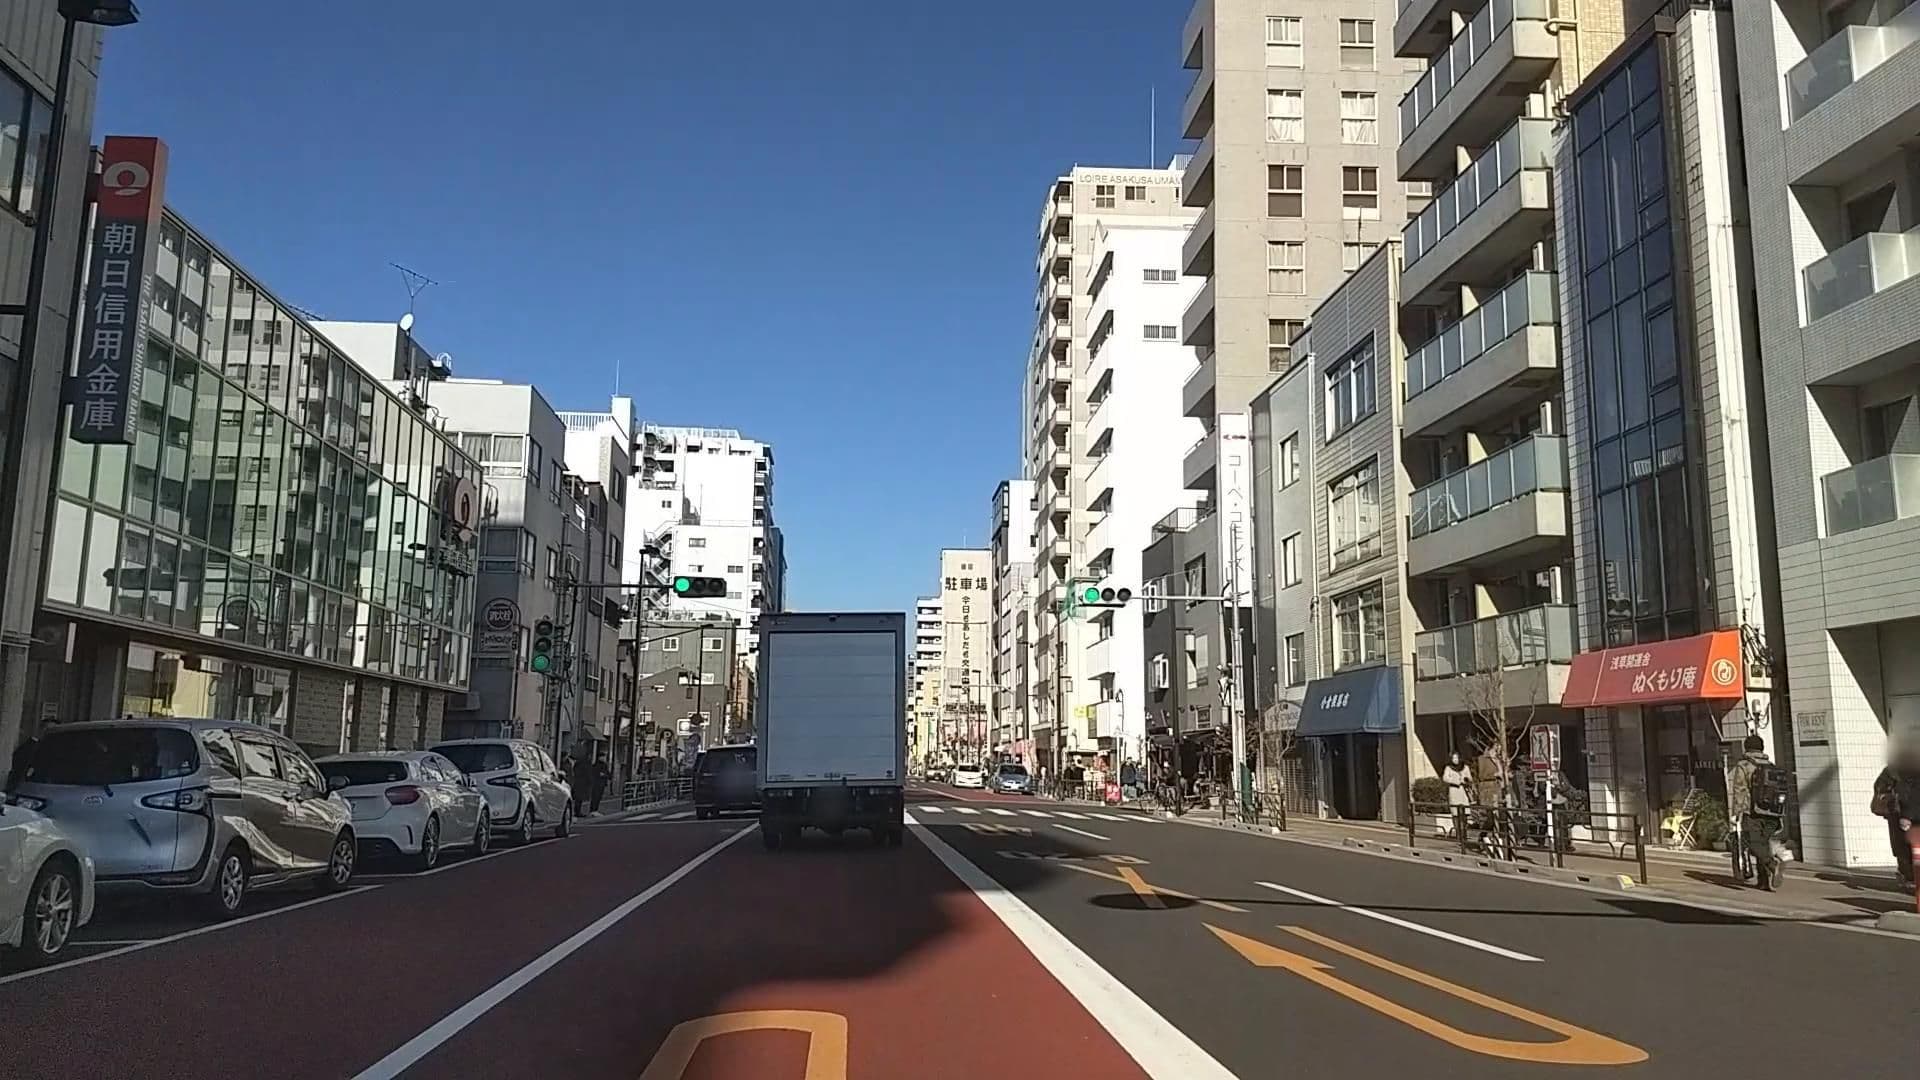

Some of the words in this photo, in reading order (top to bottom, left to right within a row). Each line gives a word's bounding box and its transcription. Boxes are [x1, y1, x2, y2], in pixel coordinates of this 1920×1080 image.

[1080, 174, 1107, 184] LOIRE
[1110, 175, 1153, 185] ASAKUSA
[80, 223, 137, 431] 朝日信用金庫
[945, 577, 989, 591] 駐車場
[1632, 665, 1697, 693] ぬくもり庵
